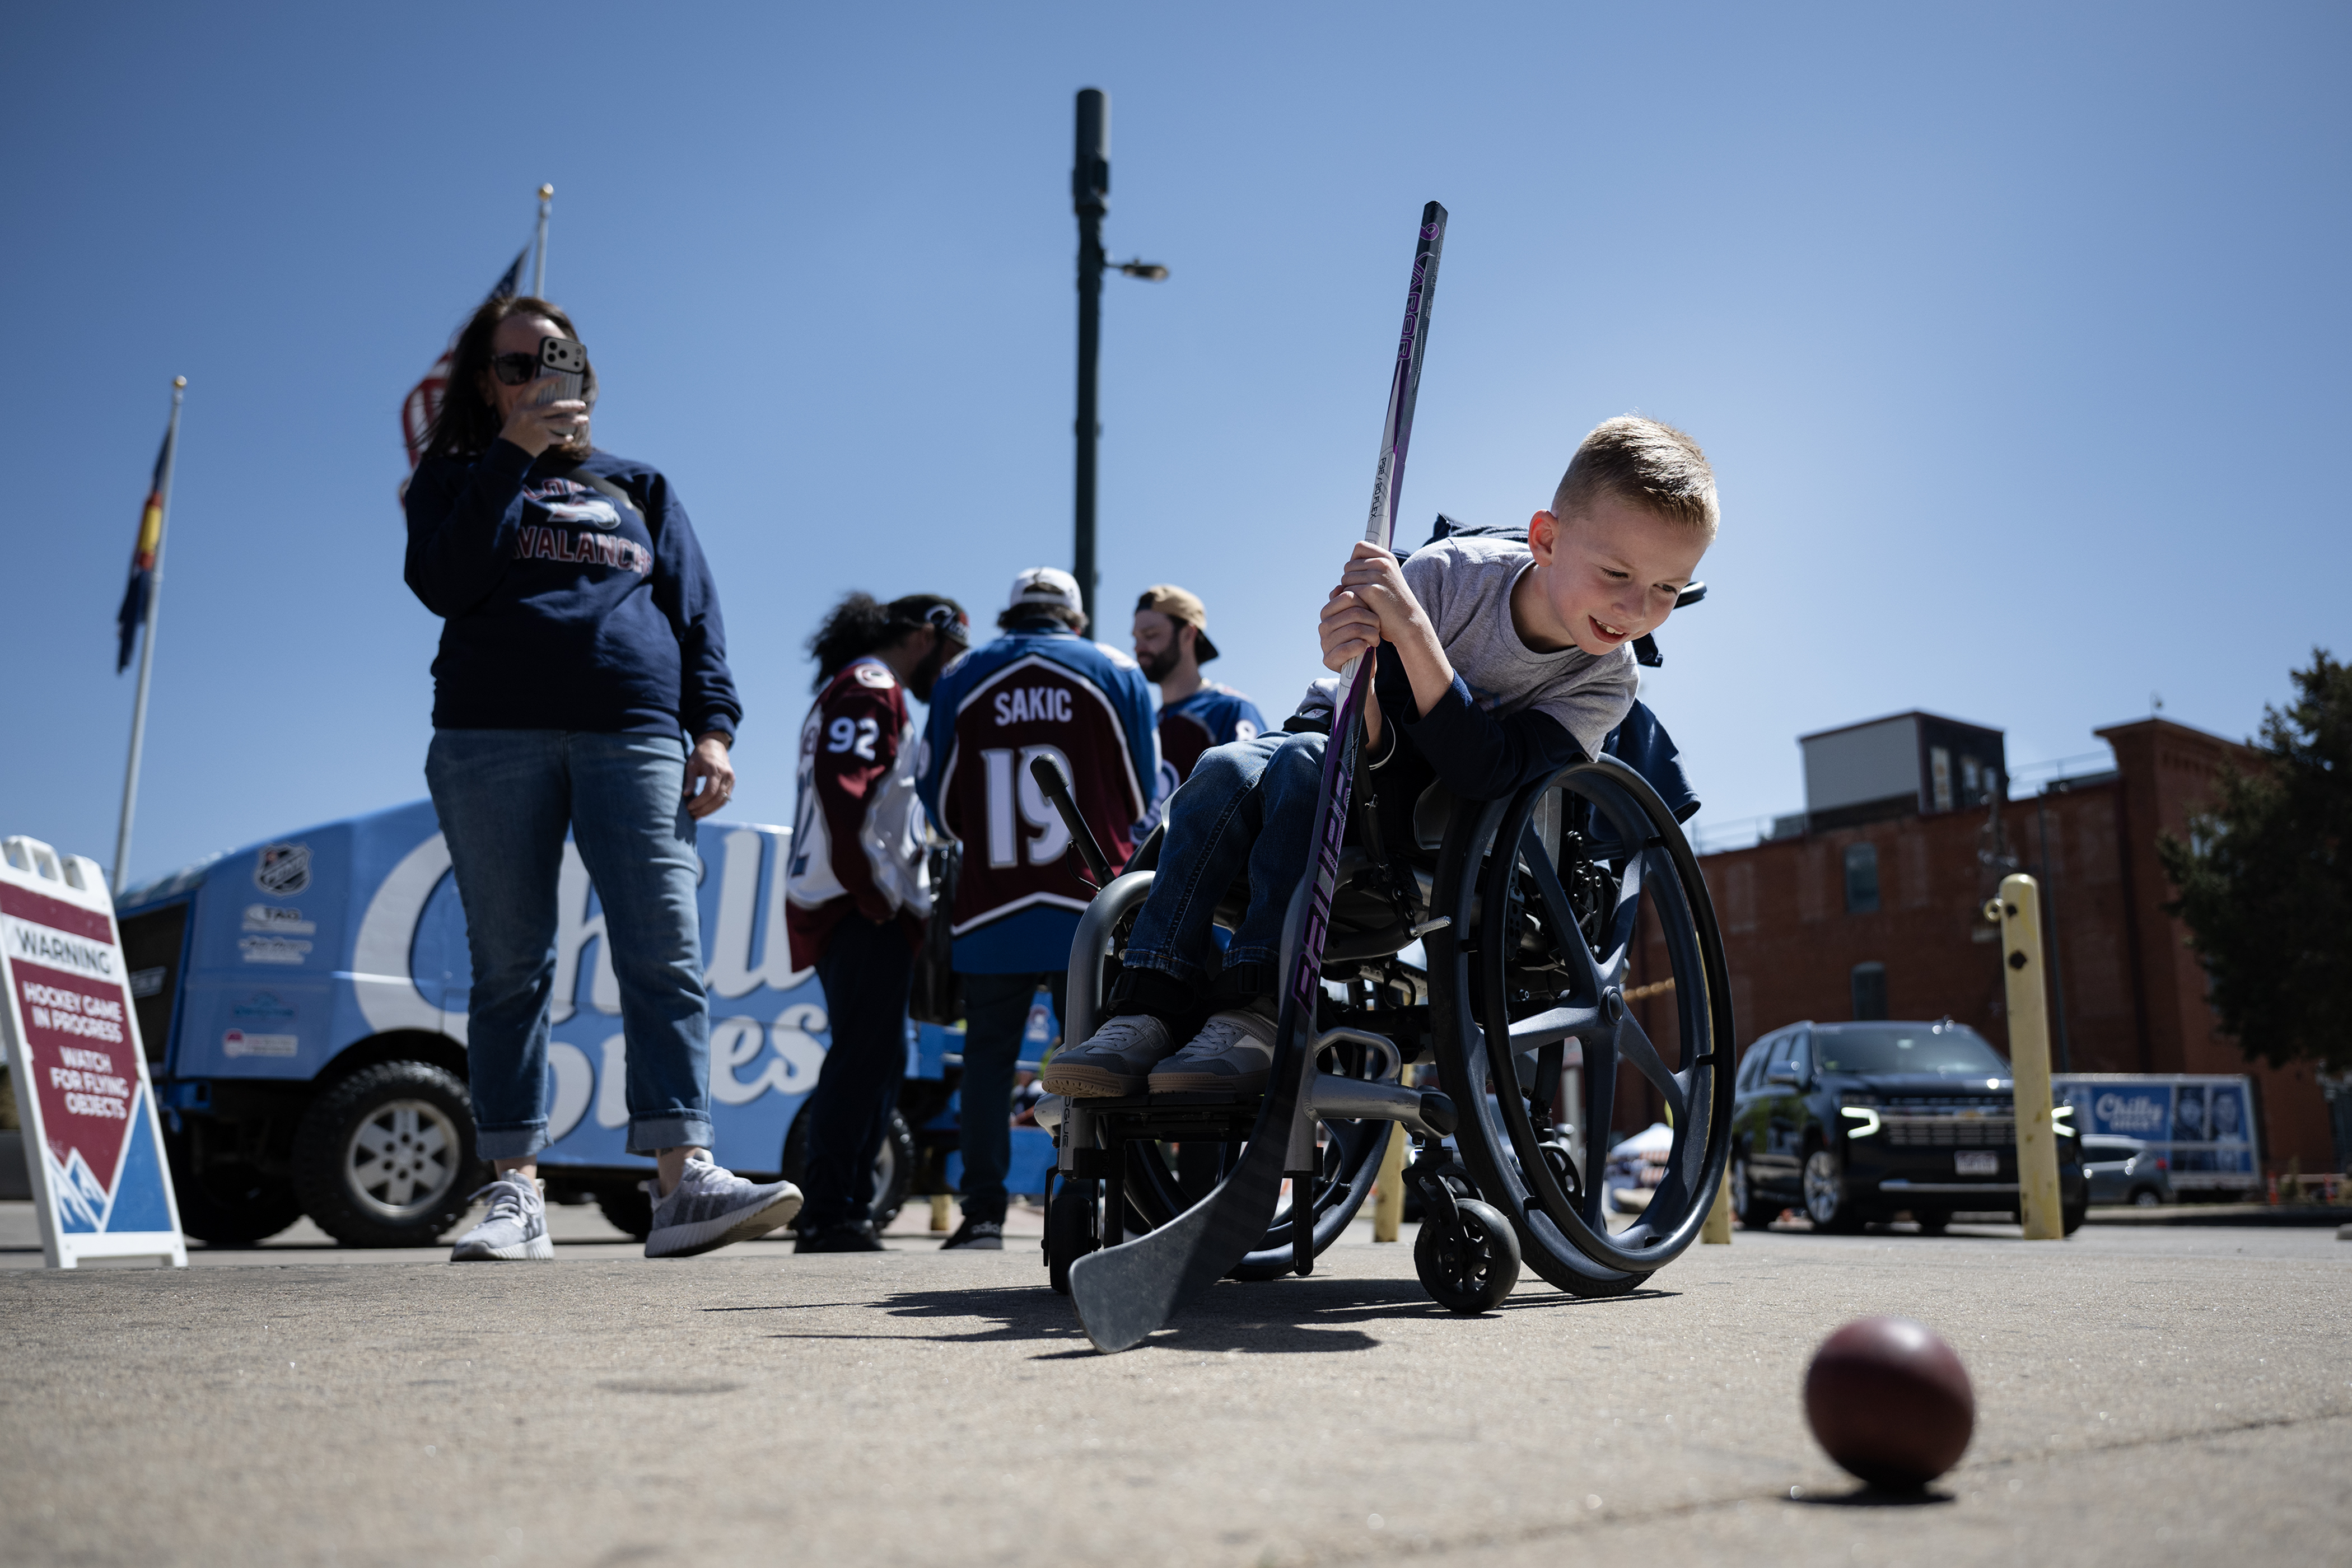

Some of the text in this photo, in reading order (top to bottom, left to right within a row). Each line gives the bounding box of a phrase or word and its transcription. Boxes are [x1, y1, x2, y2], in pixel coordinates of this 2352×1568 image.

[1378, 457, 1387, 475] P92
[1370, 496, 1380, 520] FLEX
[1374, 482, 1382, 495] 20
[514, 526, 652, 577] VALANCH
[993, 686, 1073, 726] SAKIC
[827, 716, 880, 762] 92
[980, 744, 1075, 869] 19
[1292, 760, 1351, 1016] BAUER
[16, 926, 111, 974] WARNING
[353, 830, 824, 1036] Chll
[22, 979, 124, 1023] HOCKEY GAME
[31, 1004, 124, 1044] IN PROGRESS
[58, 1045, 113, 1075] WATCH
[49, 1066, 130, 1099] FOR FLYING
[64, 1091, 127, 1120] OBJECTS
[1062, 1096, 1071, 1147] OGUE
[2095, 1093, 2163, 1130] Chilly
